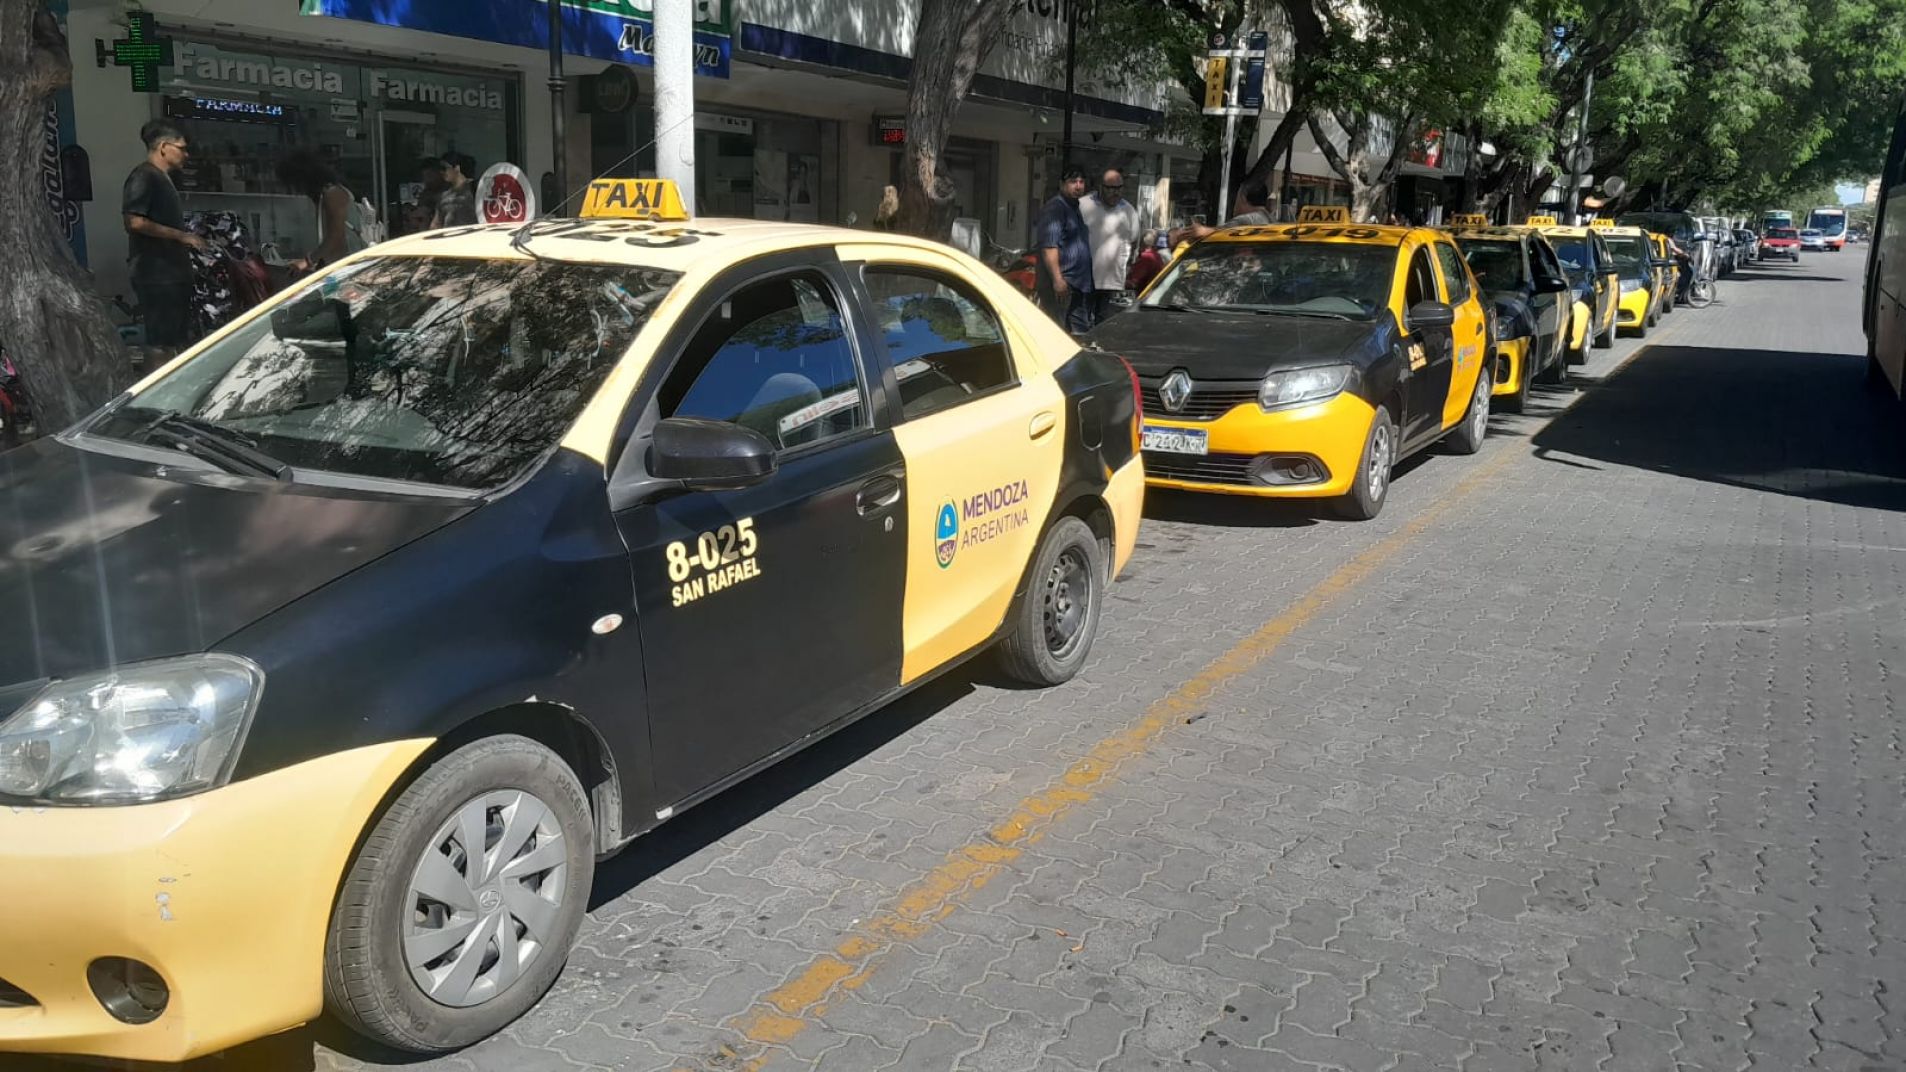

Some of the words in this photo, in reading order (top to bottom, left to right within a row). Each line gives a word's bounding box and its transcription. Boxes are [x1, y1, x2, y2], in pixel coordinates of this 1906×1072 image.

[173, 40, 343, 93] Farmacia
[1212, 59, 1222, 104] TAXI
[370, 71, 503, 110] Farmacia
[591, 182, 663, 209] TAXI
[1303, 209, 1342, 222] TAXI
[1454, 216, 1482, 225] TAXI
[1531, 217, 1552, 225] TAXI
[963, 479, 1028, 521] MENDOZA
[666, 516, 757, 582] 8-025
[961, 508, 1029, 551] ARGENTINA
[672, 577, 705, 607] SAN
[706, 557, 761, 594] RAFAEL
